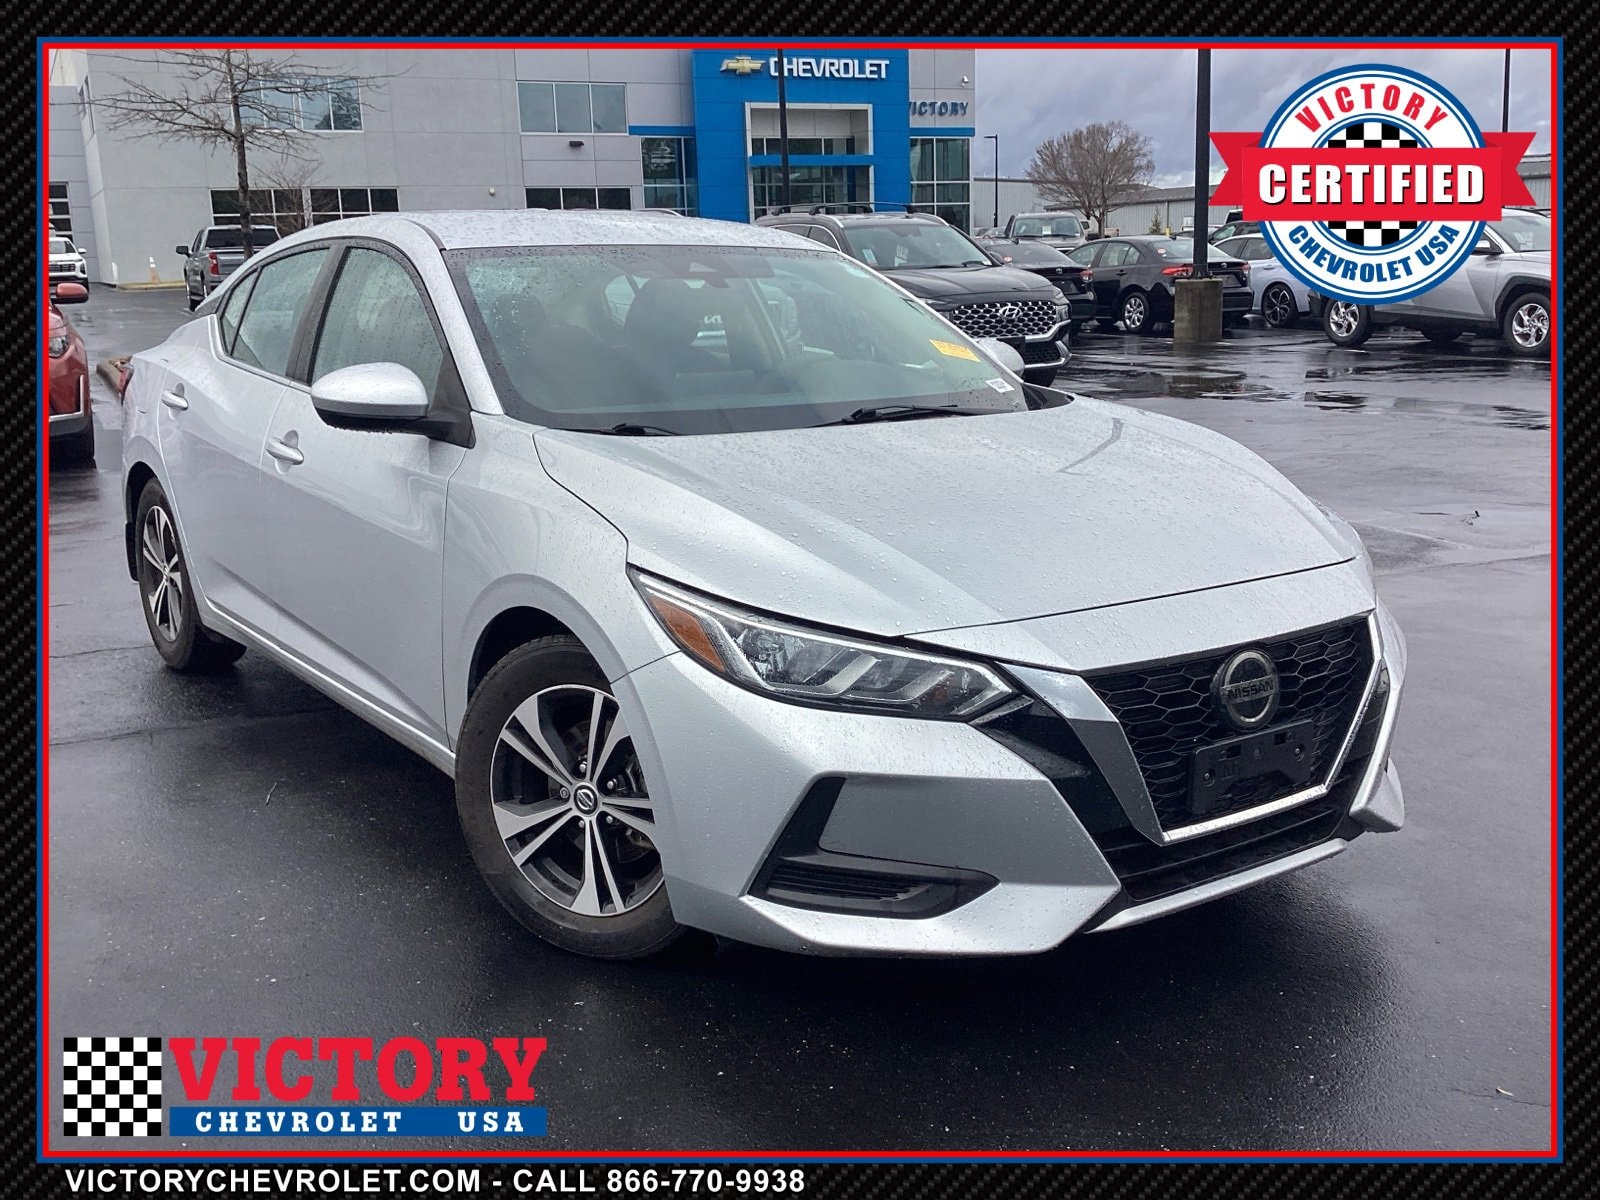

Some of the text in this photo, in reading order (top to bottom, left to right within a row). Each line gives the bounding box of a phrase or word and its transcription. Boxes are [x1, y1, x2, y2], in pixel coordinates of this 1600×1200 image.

[769, 57, 889, 79] CHEVROLET
[908, 101, 968, 116] ICTORY
[1228, 680, 1274, 700] NISSAN
